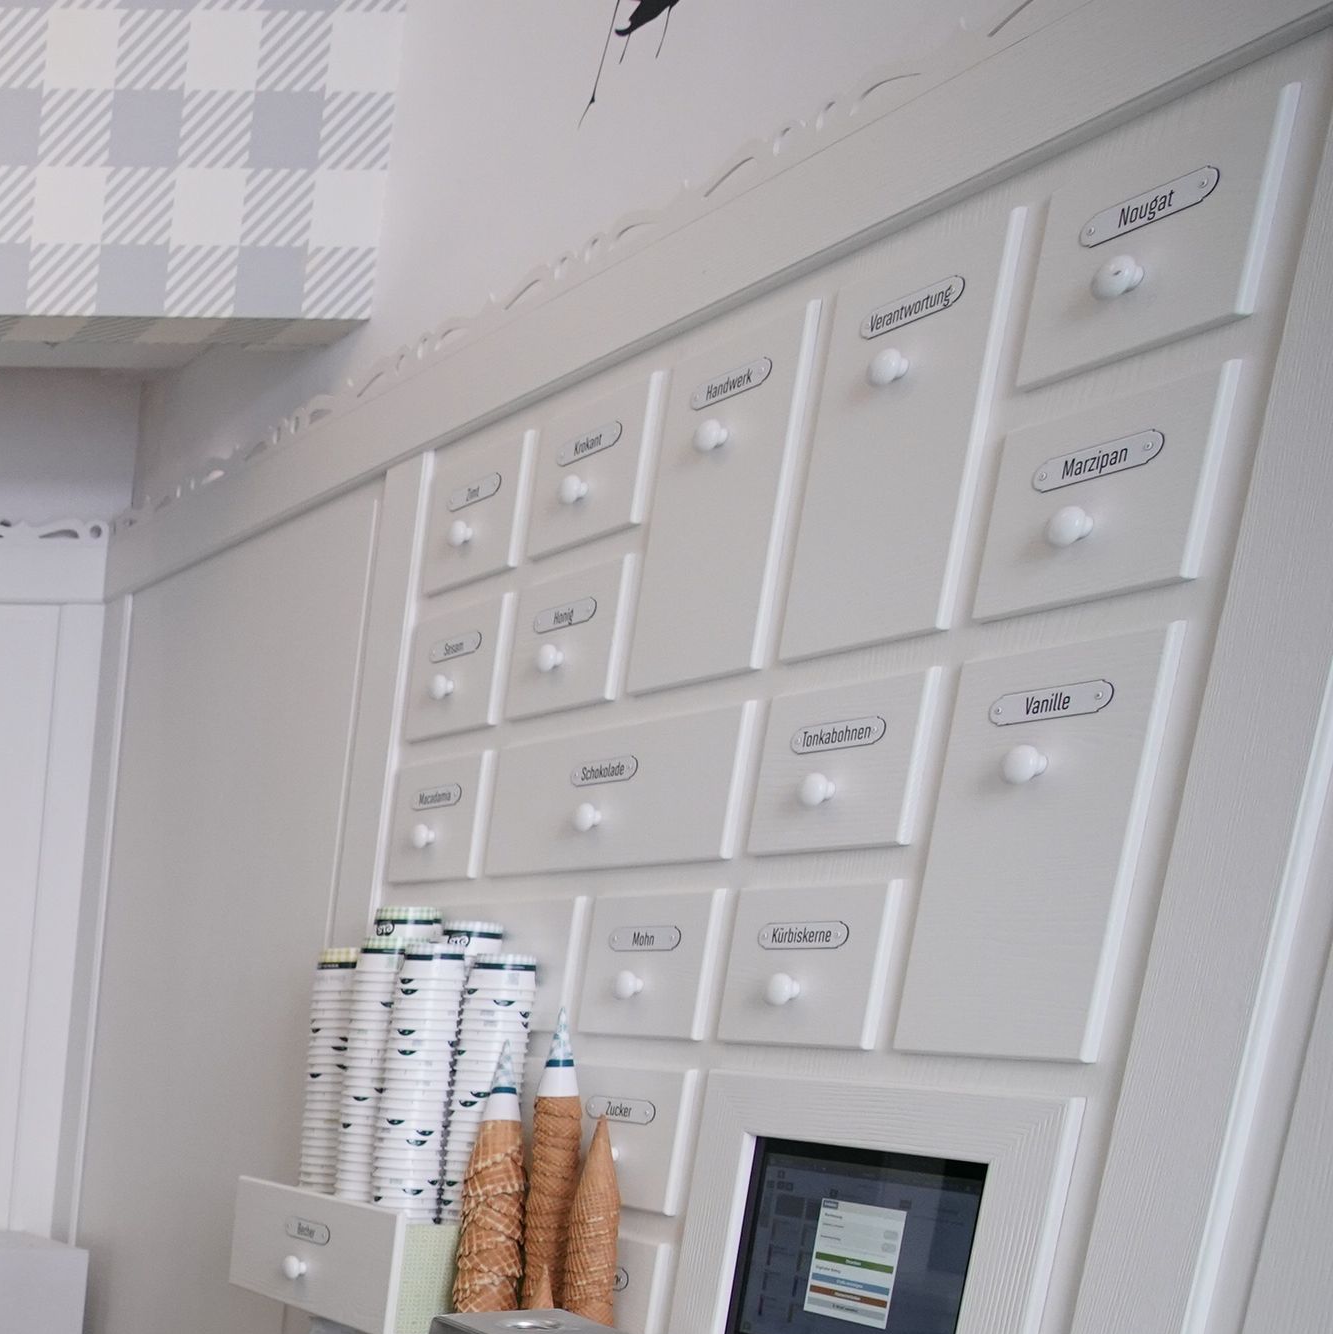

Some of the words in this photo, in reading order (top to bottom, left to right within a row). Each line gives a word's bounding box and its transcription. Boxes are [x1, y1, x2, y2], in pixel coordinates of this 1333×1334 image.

[1118, 190, 1175, 229] Nougat
[869, 284, 953, 333] Verantwortung
[705, 367, 753, 402] Handwerk
[573, 433, 602, 456] Krokant
[1061, 447, 1128, 481] Marzipan
[553, 609, 574, 625] Honig
[1025, 693, 1071, 715] Vanille
[802, 724, 871, 748] Tonkabohnen
[581, 762, 625, 781] Schokolade
[632, 930, 655, 947] Mohn
[771, 927, 832, 944] Kürbiskerne
[605, 1101, 632, 1118] Zucker
